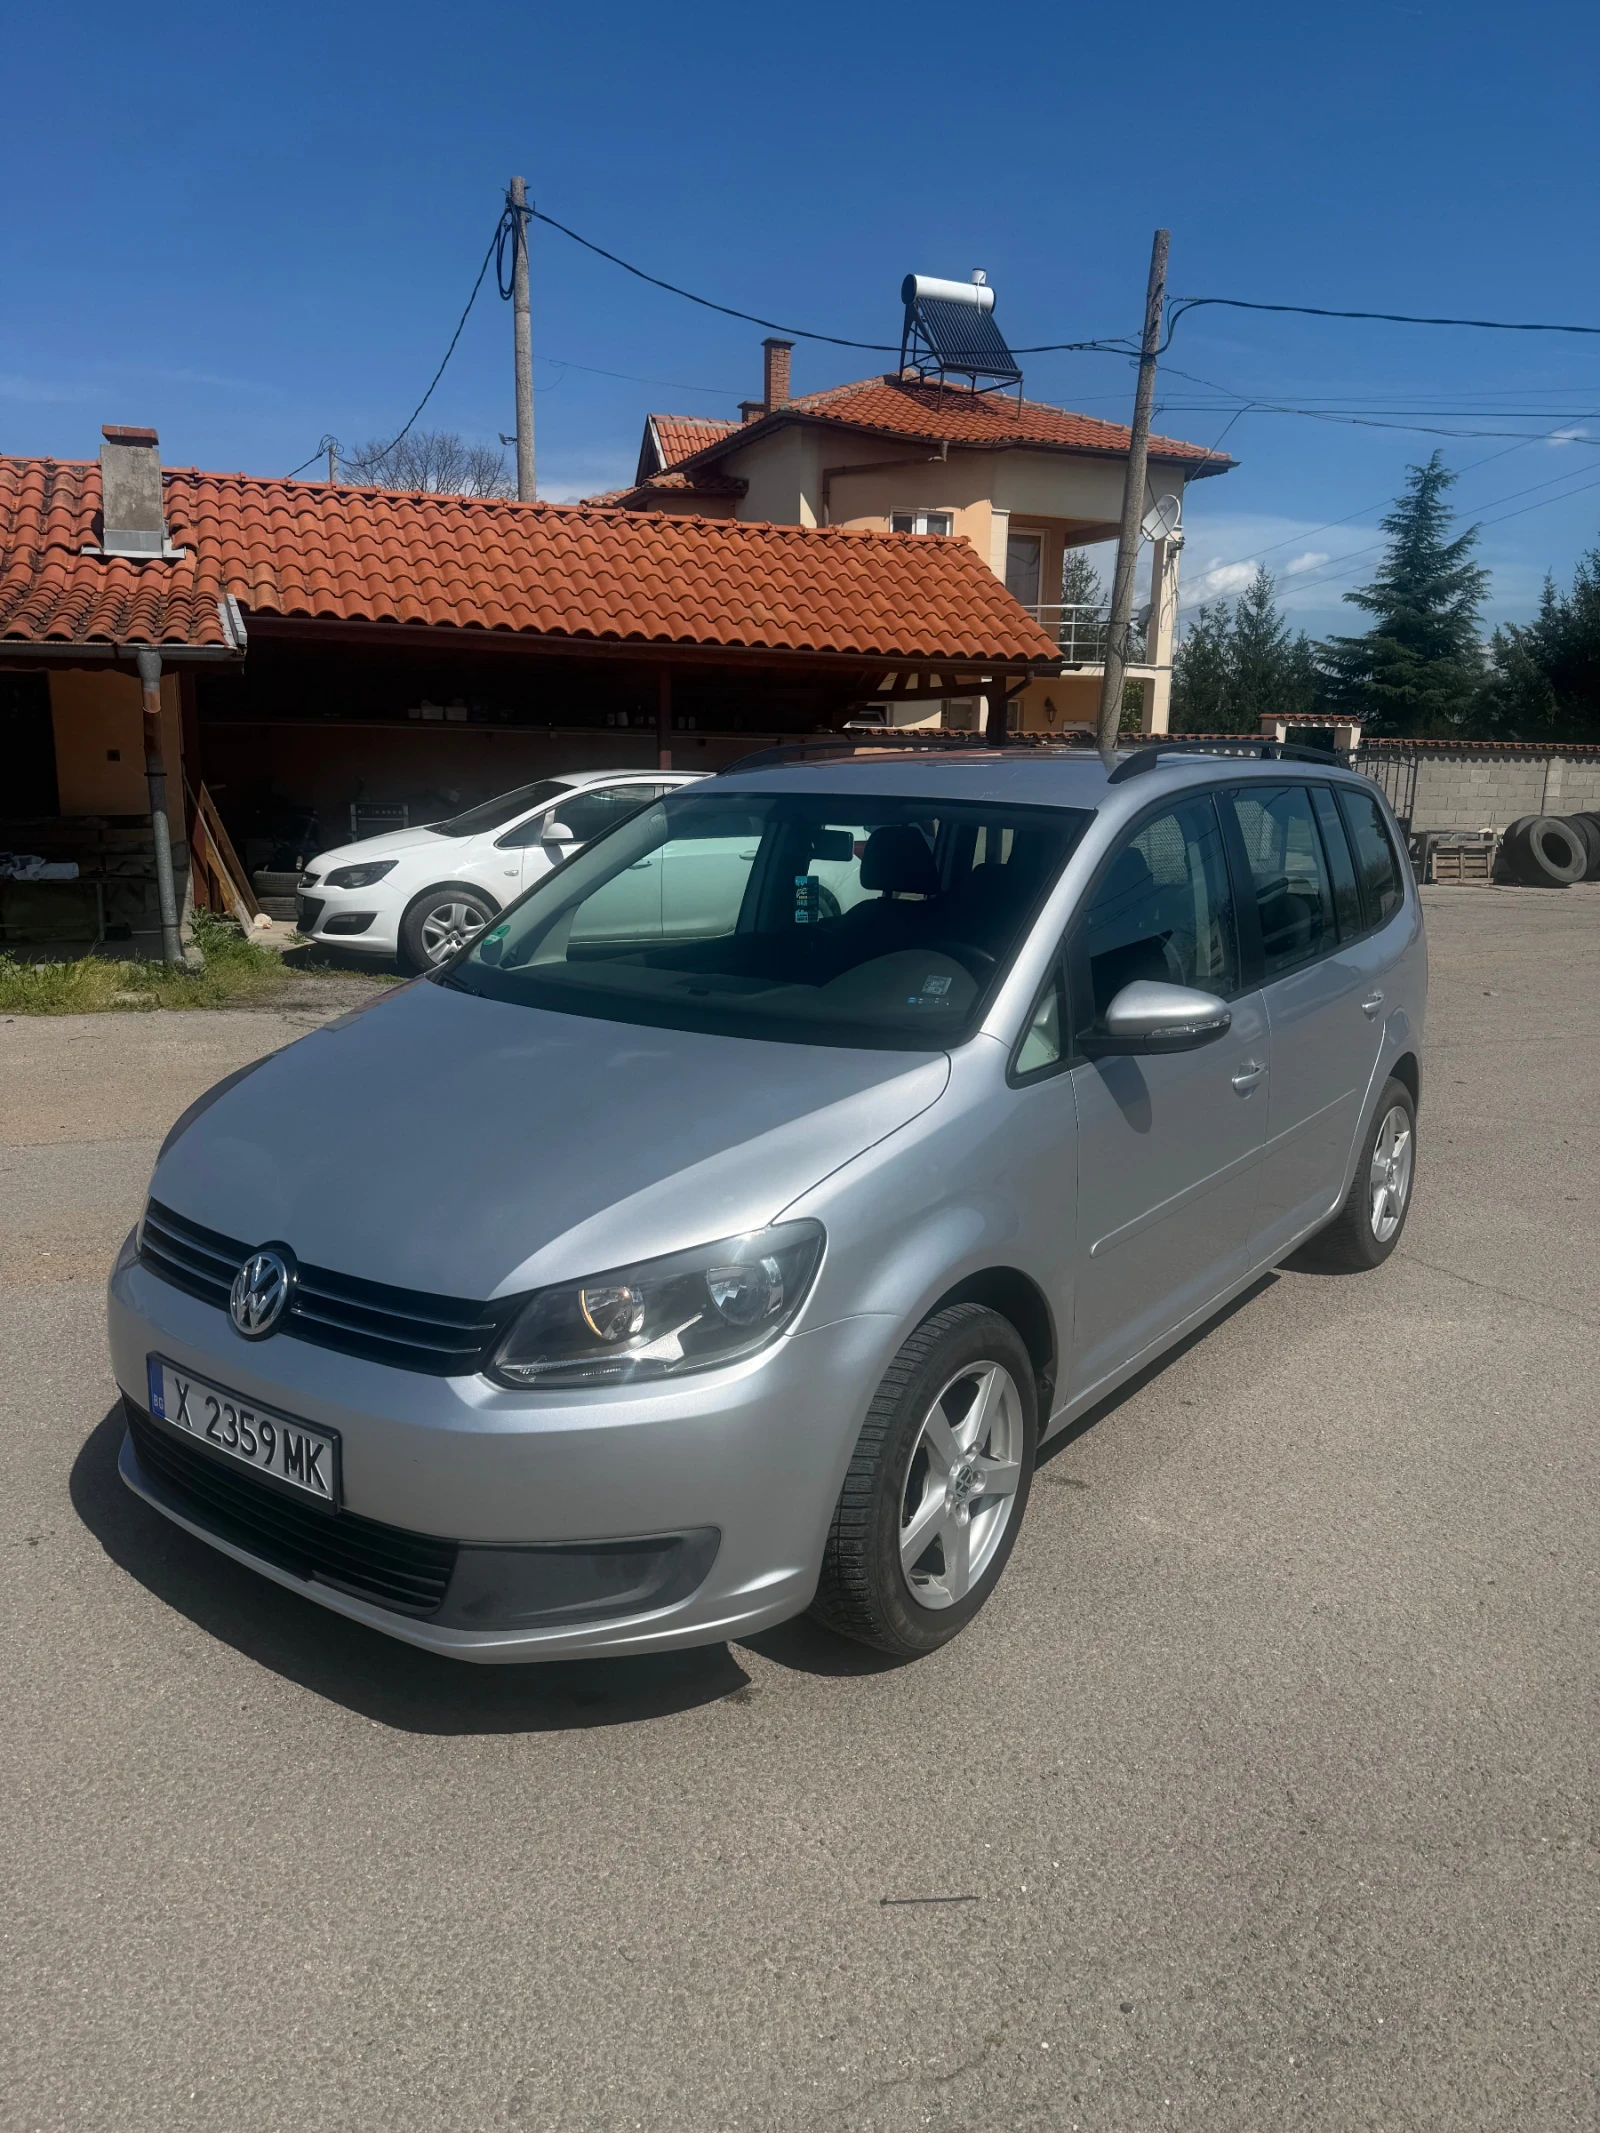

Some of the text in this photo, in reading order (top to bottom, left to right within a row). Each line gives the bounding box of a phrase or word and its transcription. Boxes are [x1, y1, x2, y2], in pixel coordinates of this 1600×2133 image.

[153, 1394, 164, 1410] BG
[175, 1377, 328, 1492] X 2359 MK
